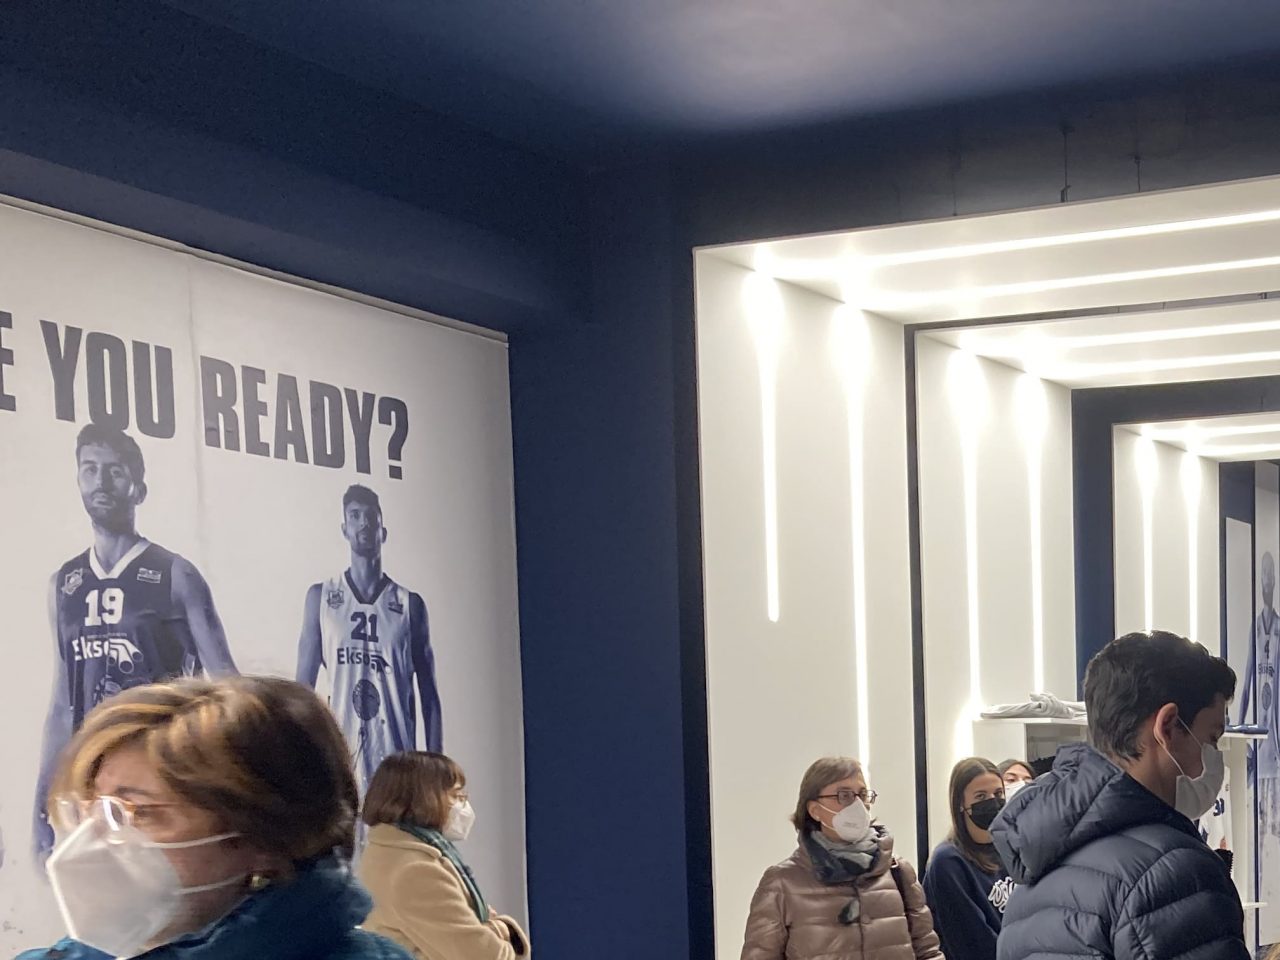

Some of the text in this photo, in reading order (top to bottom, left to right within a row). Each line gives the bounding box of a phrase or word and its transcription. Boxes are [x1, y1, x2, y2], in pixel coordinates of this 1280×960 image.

[39, 319, 176, 439] YOU
[200, 355, 409, 480] READY?
[84, 587, 124, 627] 19
[350, 611, 379, 643] 21
